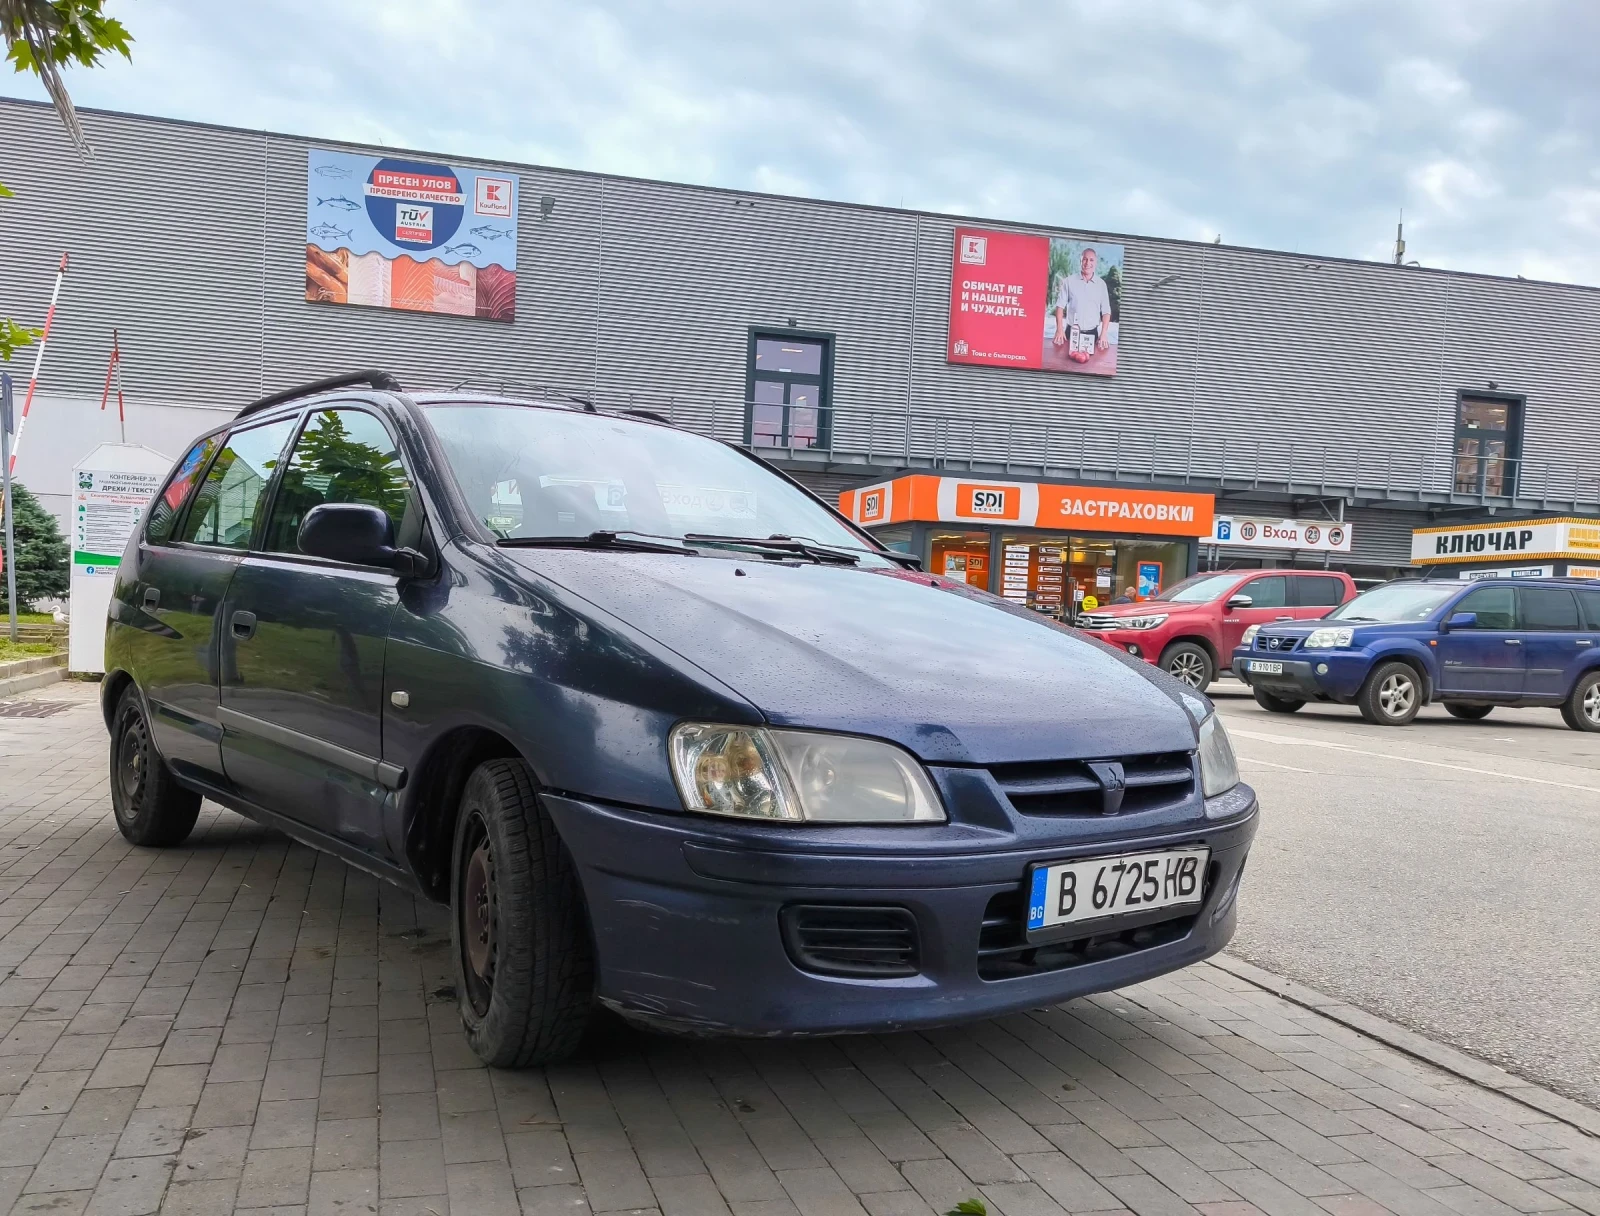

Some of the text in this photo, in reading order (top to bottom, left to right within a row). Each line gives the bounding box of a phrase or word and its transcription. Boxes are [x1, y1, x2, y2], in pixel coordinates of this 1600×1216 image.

[378, 174, 452, 190] ПРЕСЕН УЛОВ
[369, 187, 461, 203] ПРОВЕРЕНО КАЧЕСТВО
[479, 201, 508, 212] Kaufland
[962, 280, 1023, 295] ОБИЧАТ МЕ
[961, 292, 1021, 307] И НАШИТЕ,
[960, 302, 1028, 318] И ЧУЖДИТЕ.
[109, 473, 148, 482] КОНТЕЙНЕР
[866, 495, 878, 512] SDI
[973, 491, 1003, 508] SDI
[1060, 498, 1194, 522] ЗАСТРАХОВКИ
[1243, 527, 1253, 537] 10
[1263, 525, 1298, 541] Вход
[1436, 530, 1533, 555] КЛЮЧАР
[1058, 871, 1077, 917] B
[1029, 905, 1043, 921] BG
